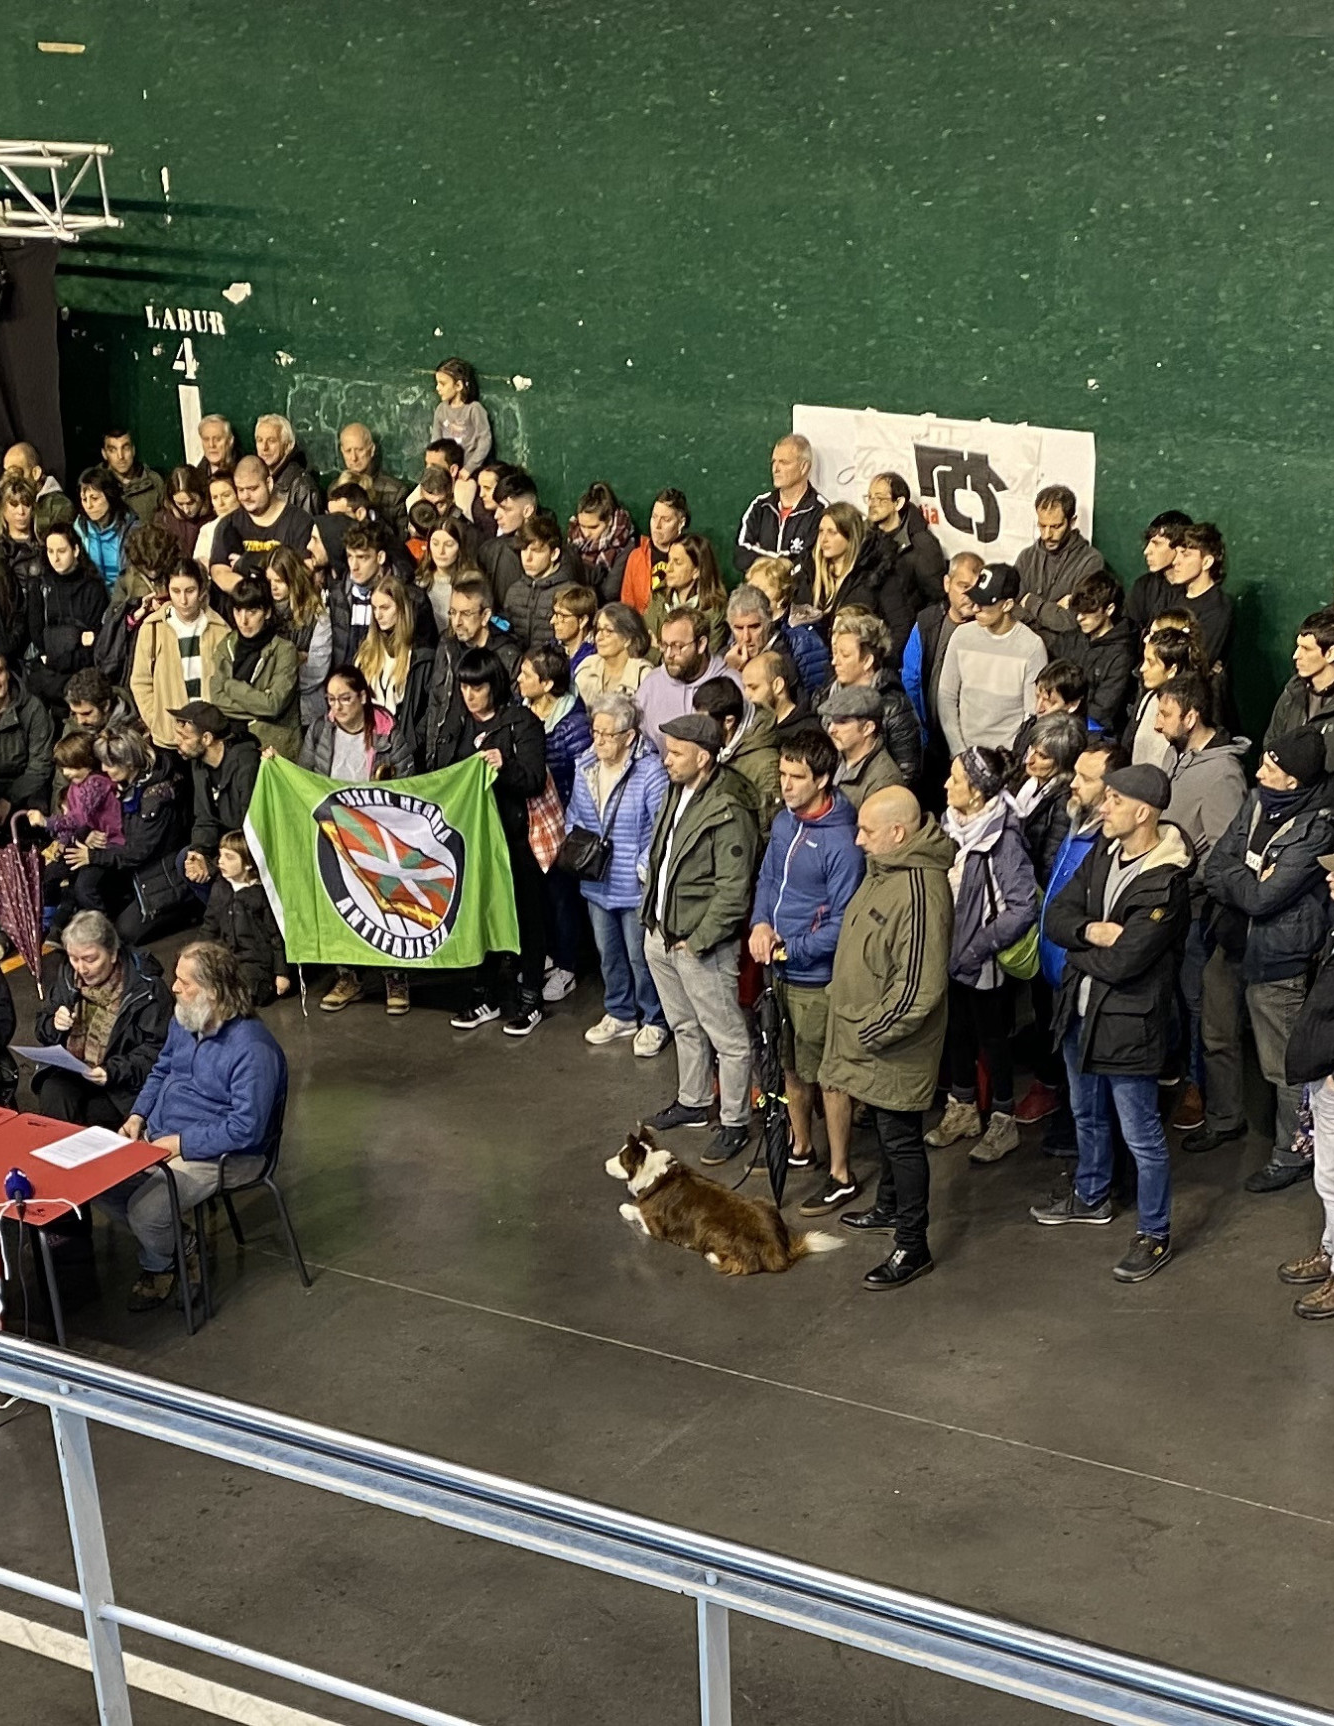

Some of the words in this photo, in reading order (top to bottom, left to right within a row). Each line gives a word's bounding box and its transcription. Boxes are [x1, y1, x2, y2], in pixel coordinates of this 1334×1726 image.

[145, 305, 225, 335] LABUR
[172, 337, 199, 380] 4
[337, 788, 393, 807] EUSKAL
[335, 897, 449, 958] ANTIFAXISTA
